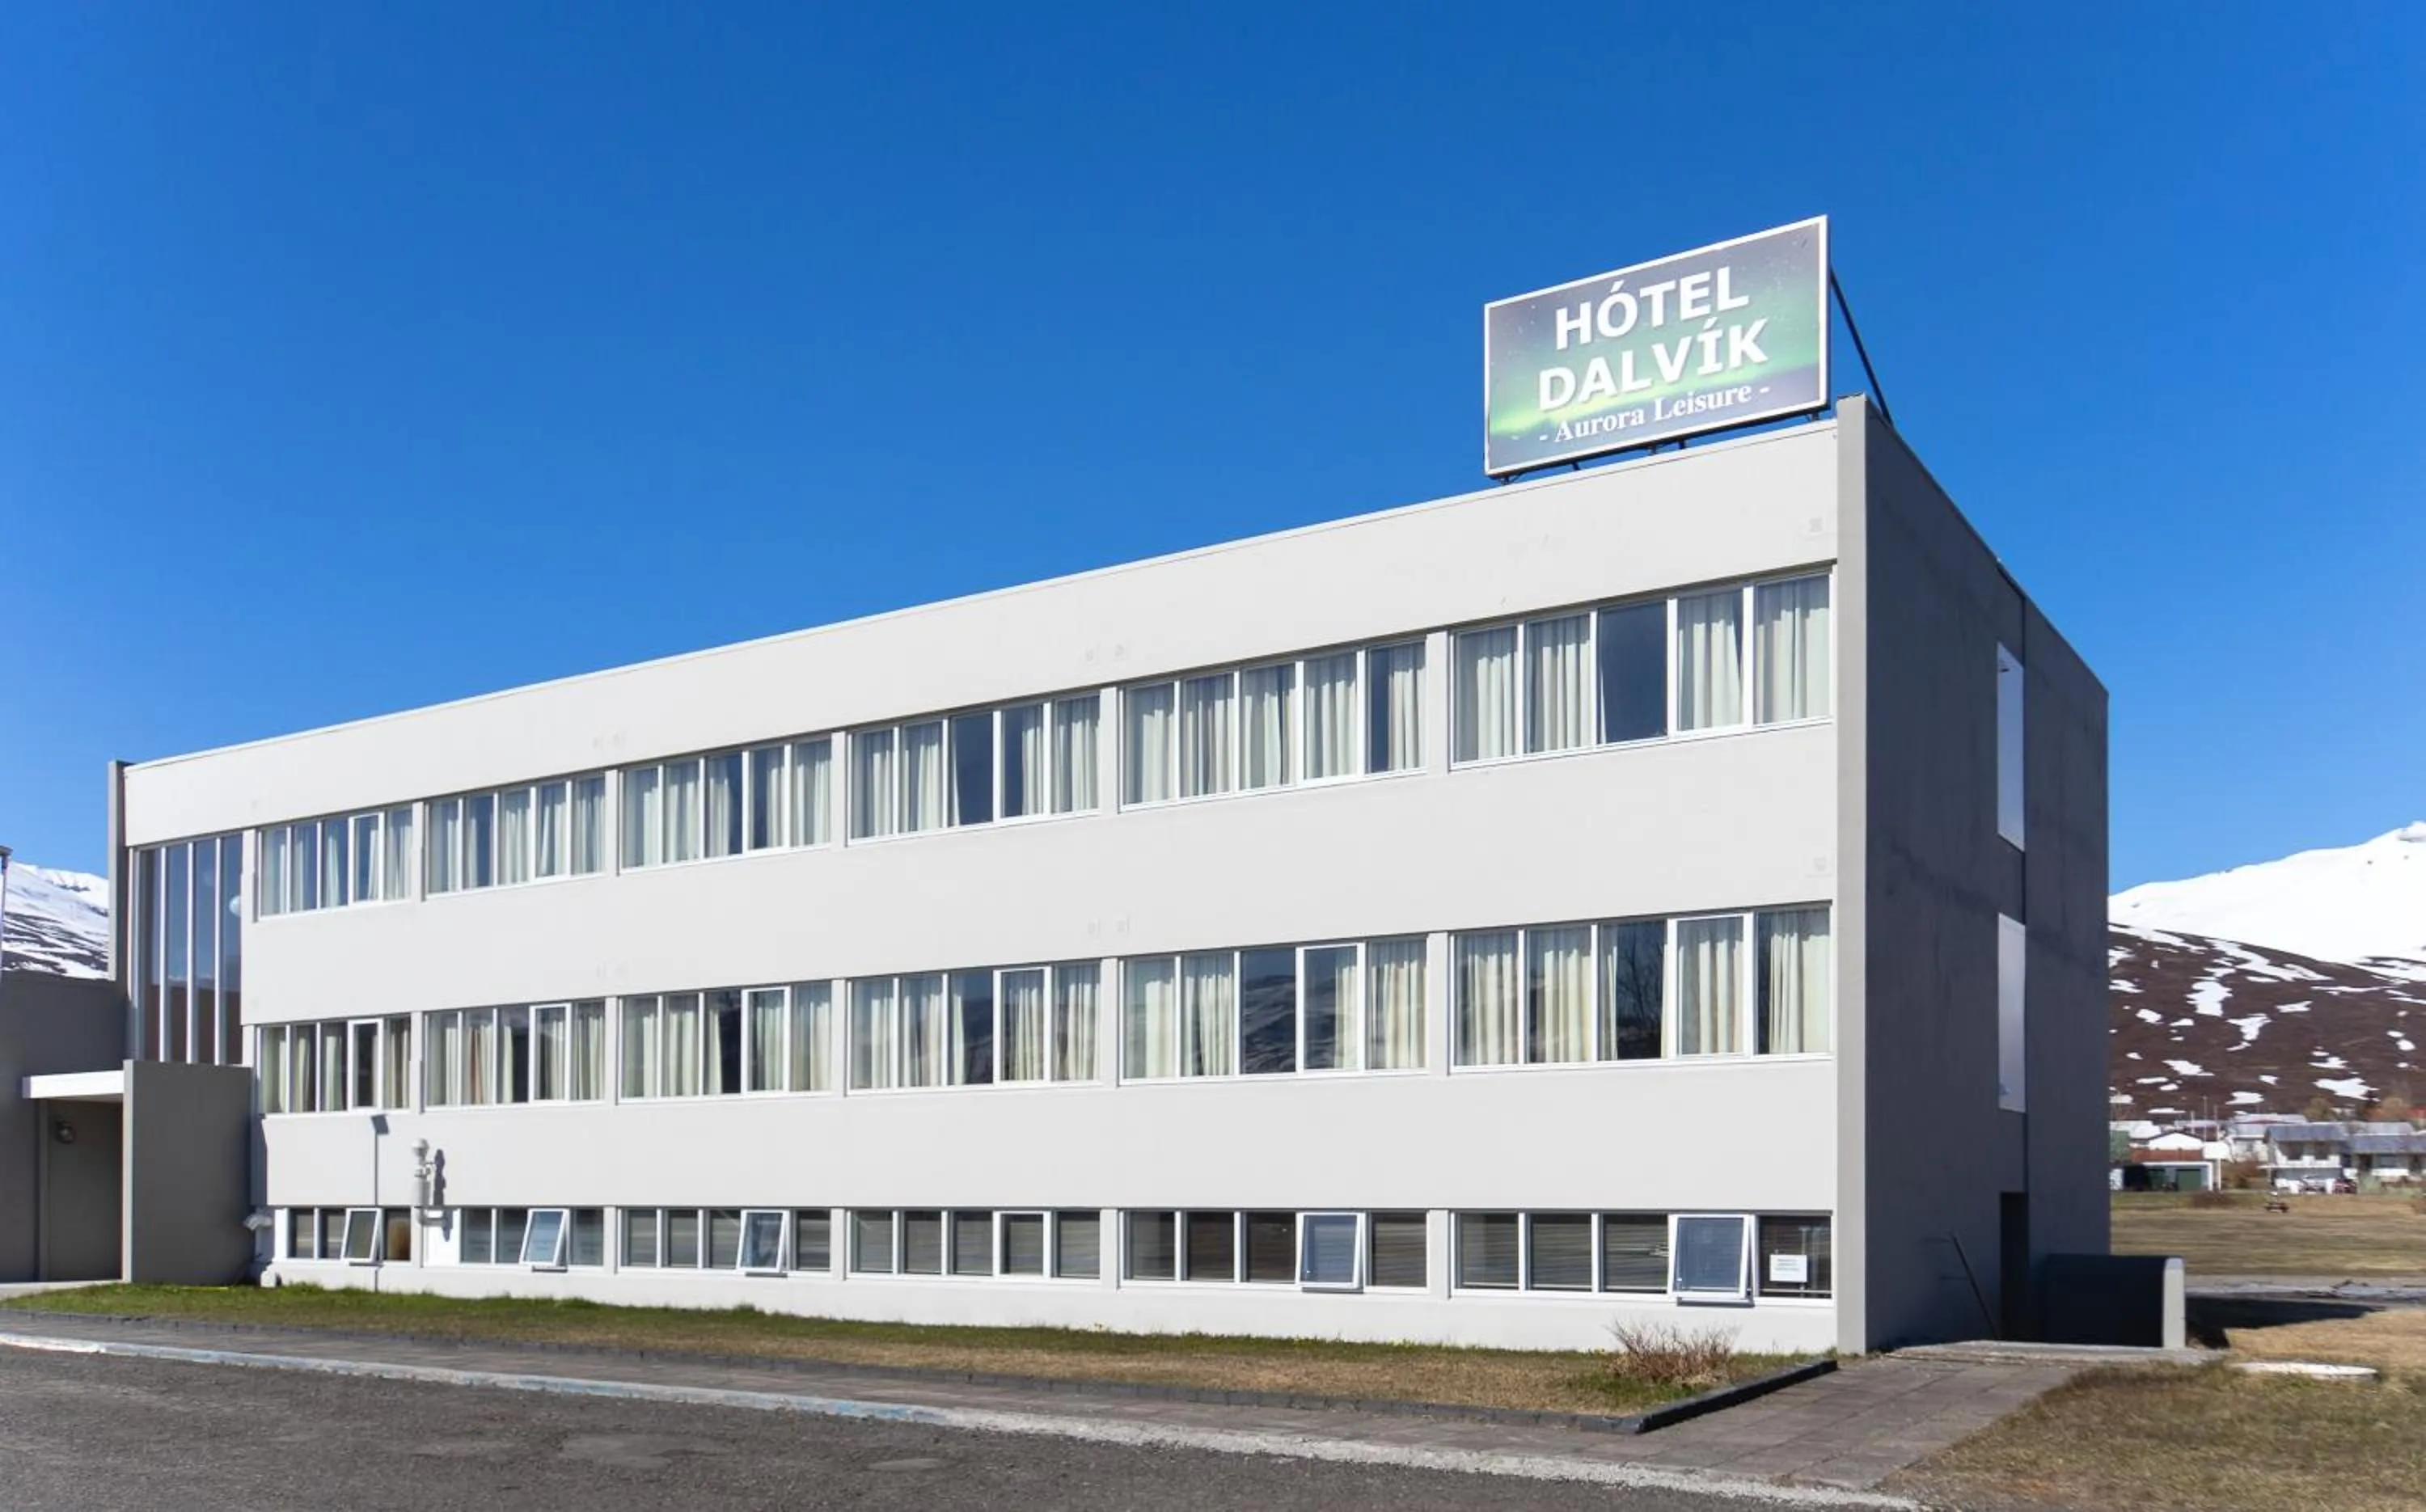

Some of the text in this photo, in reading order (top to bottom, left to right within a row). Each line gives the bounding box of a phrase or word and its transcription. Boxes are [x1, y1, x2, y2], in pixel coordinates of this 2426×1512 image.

[1556, 267, 1749, 350] HÓTEL
[1539, 318, 1769, 411] DALVÍK
[1554, 410, 1645, 443] Aurora
[1654, 384, 1753, 421] Leisure
